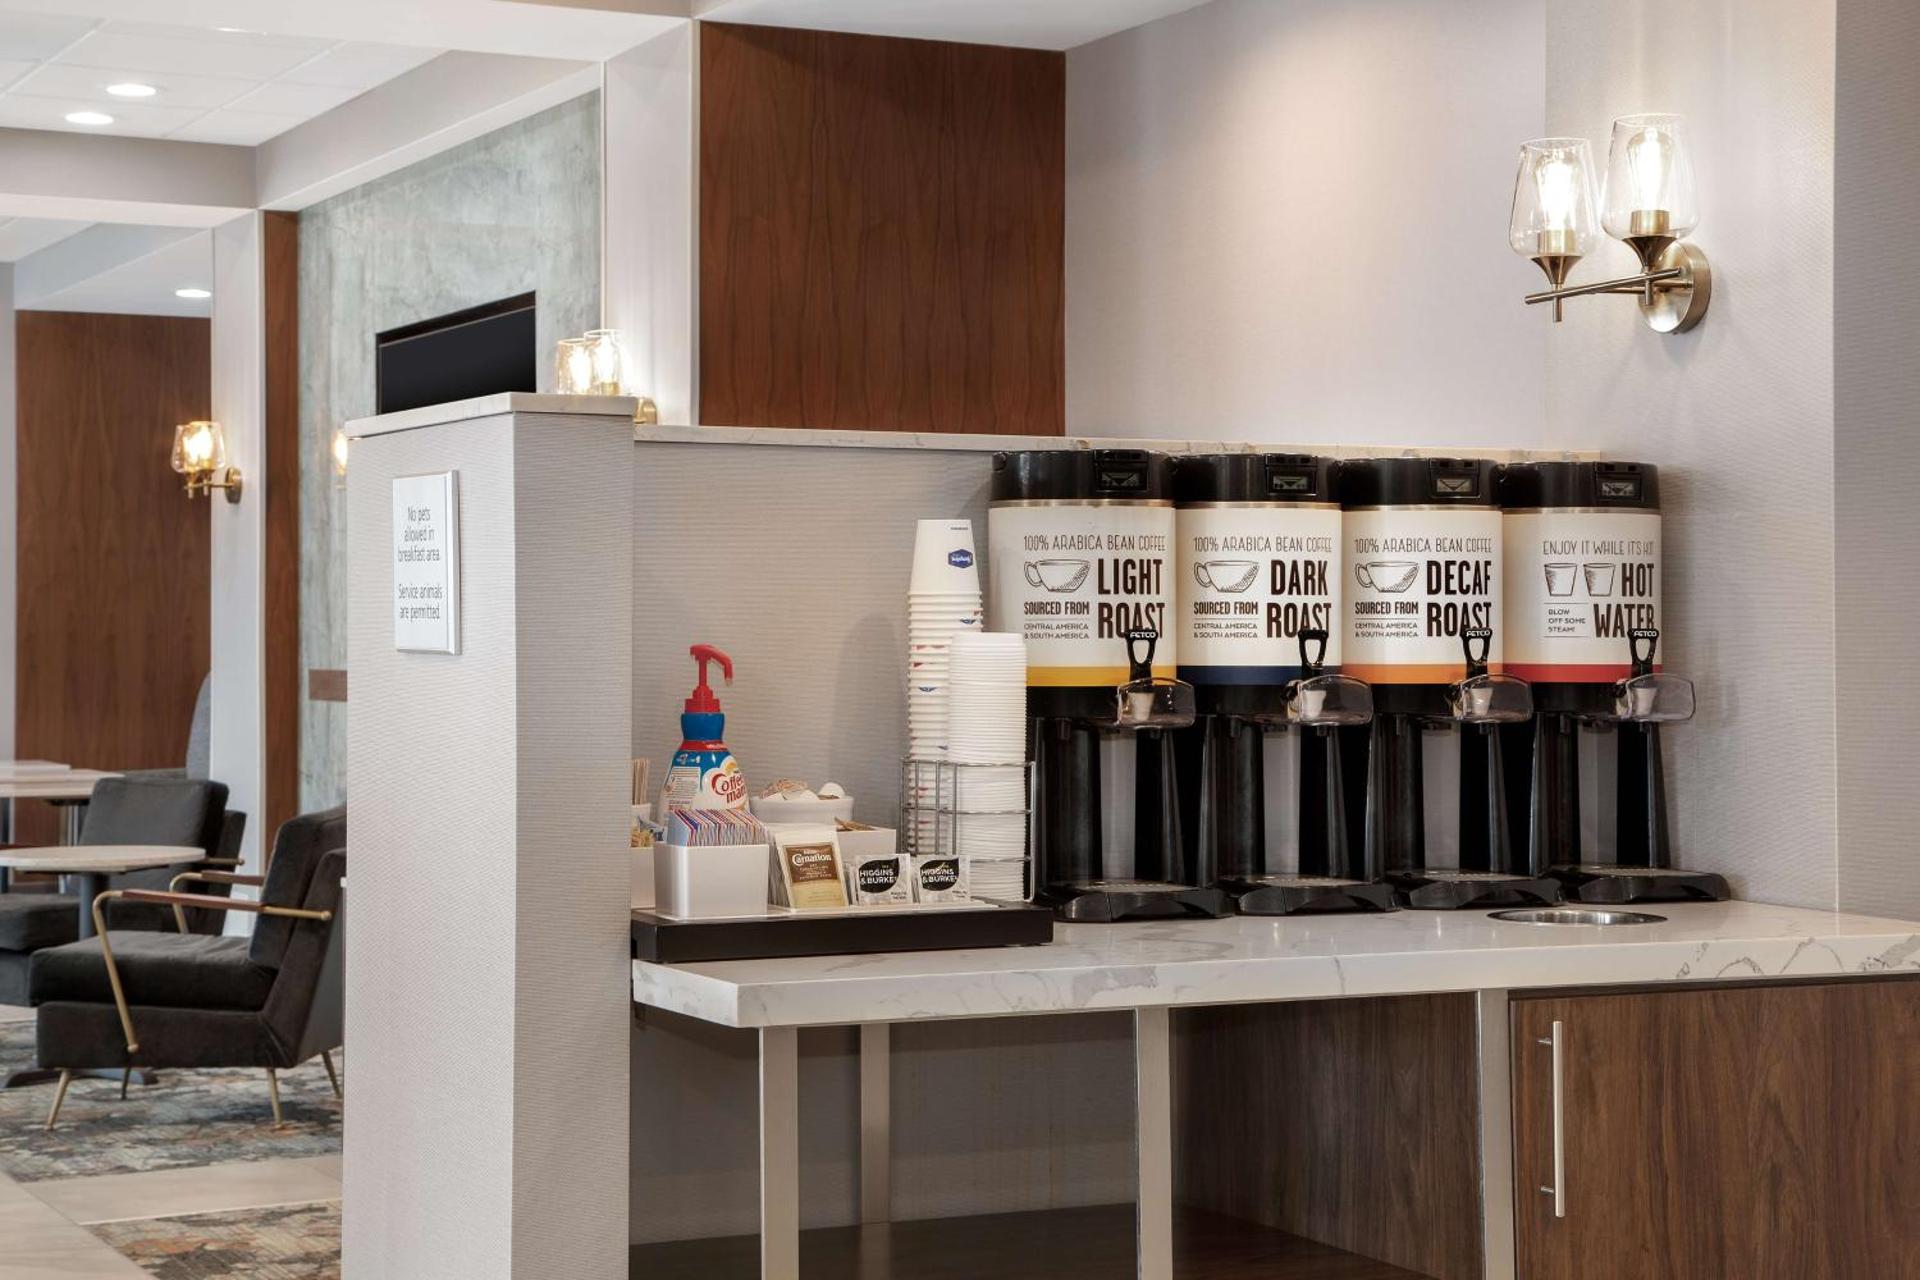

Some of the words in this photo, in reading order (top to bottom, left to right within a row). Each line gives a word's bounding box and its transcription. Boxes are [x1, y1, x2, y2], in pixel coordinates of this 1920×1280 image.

[408, 506, 417, 521] No
[418, 508, 431, 525] pets
[404, 526, 427, 542] allowed
[428, 525, 436, 541] in
[1023, 535, 1049, 550] 100%
[1053, 535, 1103, 550] ARABICA
[1107, 535, 1135, 550] BEAN
[1138, 535, 1166, 552] COFFEE
[1193, 536, 1219, 552] 100%
[1222, 536, 1272, 552] ARABICA
[1276, 537, 1303, 552] BEAN
[1306, 537, 1333, 553] COFFEE
[1354, 538, 1380, 554] 100%
[1382, 538, 1432, 554] ARABICA
[1436, 538, 1463, 553] BEAN
[1466, 538, 1493, 554] COFFEE
[1543, 540, 1577, 556] ENJOY
[1581, 540, 1590, 556] IT
[1592, 540, 1625, 556] WHILE
[398, 545, 426, 562] breakfast
[1097, 558, 1163, 596] LIGHT
[1270, 559, 1329, 596] DARK
[1426, 560, 1492, 596] DECAF
[1621, 562, 1655, 598] HOT
[399, 583, 419, 599] Service
[420, 584, 443, 599] animals
[400, 607, 409, 619] are
[1023, 601, 1062, 615] SOURCED
[1064, 601, 1090, 615] FROM
[1193, 601, 1231, 615] SOURCED
[1233, 601, 1259, 615] FROM
[1354, 601, 1391, 615] SOURCED
[1394, 601, 1419, 615] FROM
[1548, 608, 1570, 616] BLOW
[1097, 602, 1166, 639] ROAST
[1193, 622, 1224, 630] CENTRAL
[1224, 622, 1258, 630] AMERICA
[1266, 602, 1332, 639] ROAST
[1354, 622, 1384, 630] CENTRAL
[1384, 622, 1418, 630] AMERICA
[1426, 602, 1492, 638] ROAST
[1548, 617, 1564, 625] OFF
[1564, 617, 1586, 625] SOME
[1593, 603, 1655, 638] WATER
[1030, 632, 1054, 640] SOUTH
[1054, 632, 1090, 640] AMERICA
[1129, 631, 1157, 639] FETCO
[1359, 631, 1384, 639] SOUTH
[1384, 631, 1419, 639] AMERICA
[1465, 629, 1491, 637] FETCO
[1633, 630, 1658, 638] FETCO
[792, 853, 832, 867] Carnation
[860, 868, 894, 877] HIGGINS
[921, 868, 955, 876] HIGGINS
[860, 878, 866, 886] &
[922, 876, 928, 884] &
